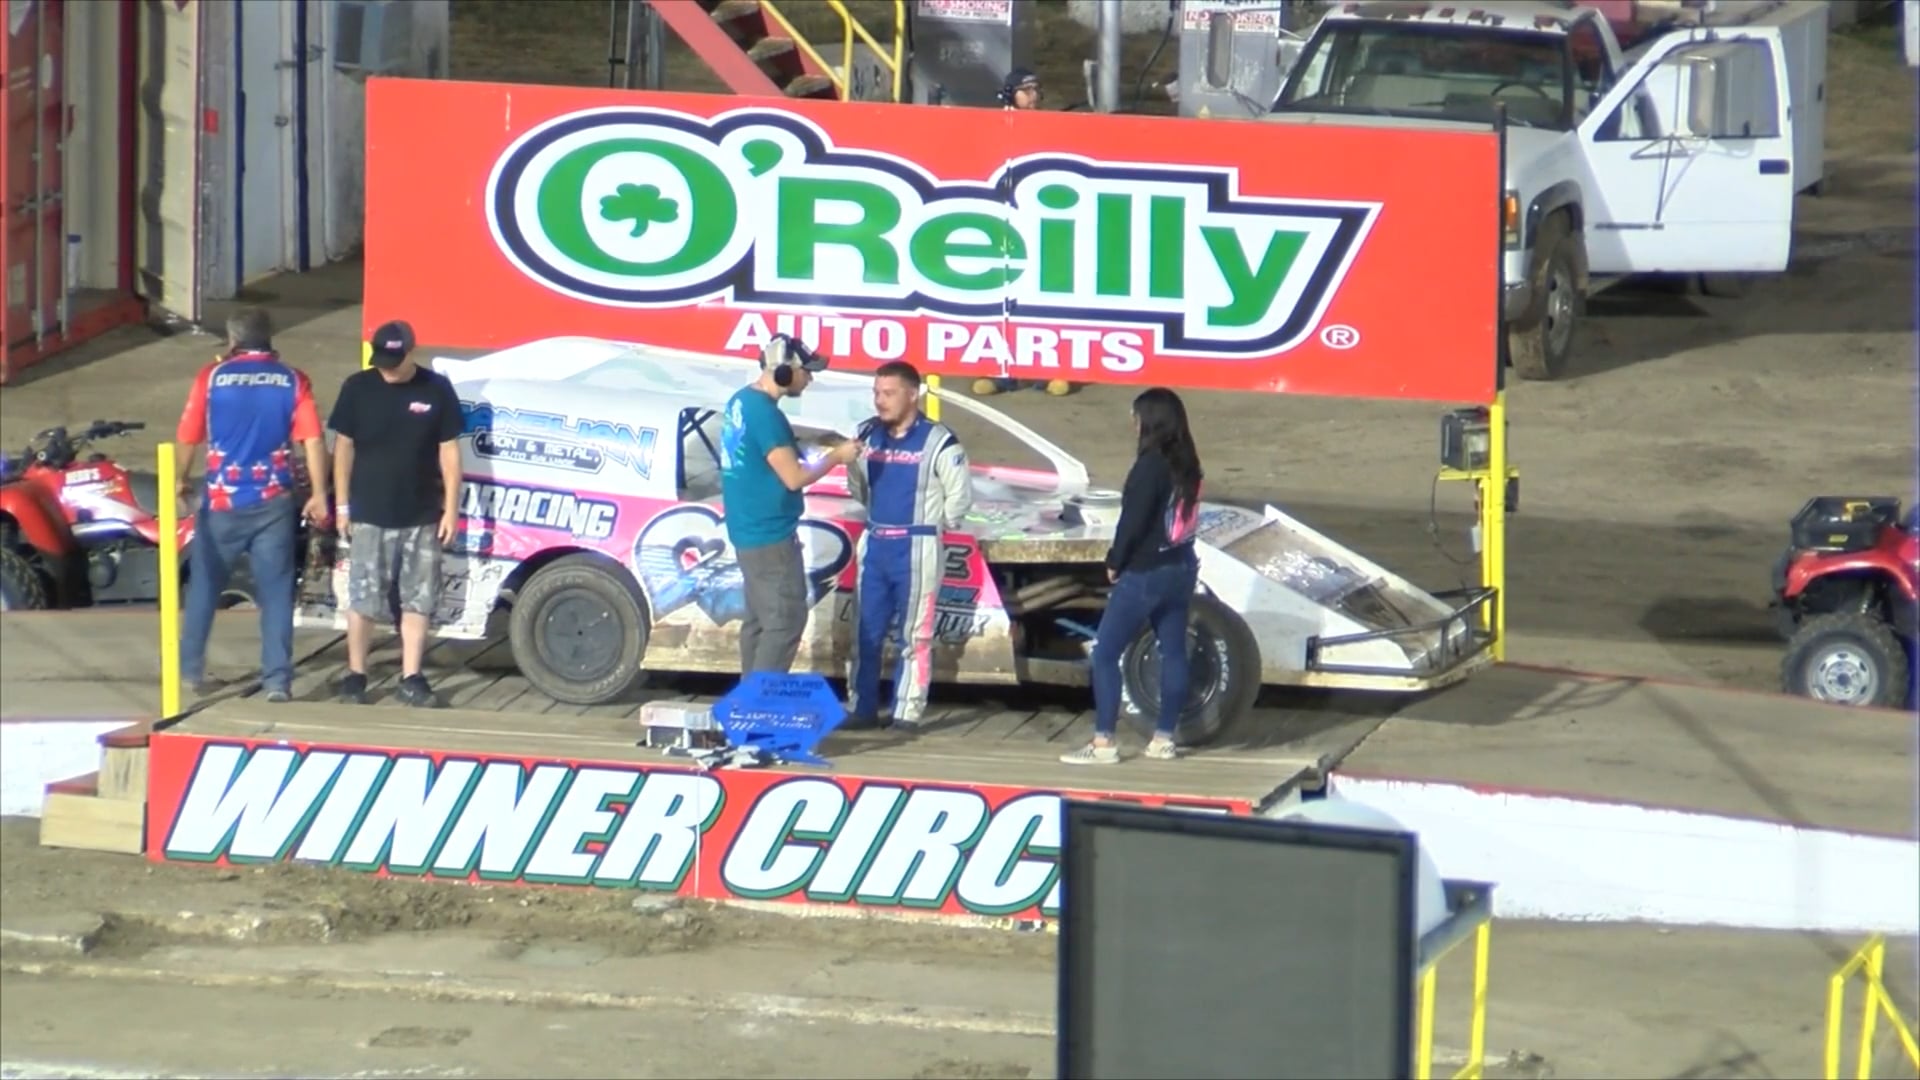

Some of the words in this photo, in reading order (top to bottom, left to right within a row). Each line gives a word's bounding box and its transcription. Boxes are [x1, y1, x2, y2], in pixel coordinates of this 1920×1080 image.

[537, 137, 1309, 327] O'Reilly
[725, 310, 909, 360] AUTO
[926, 321, 1146, 372] PARTS
[215, 371, 292, 389] OFFICIAL
[543, 444, 595, 462] METAL
[164, 742, 726, 891] WINNER
[721, 776, 1062, 917] CIRC
